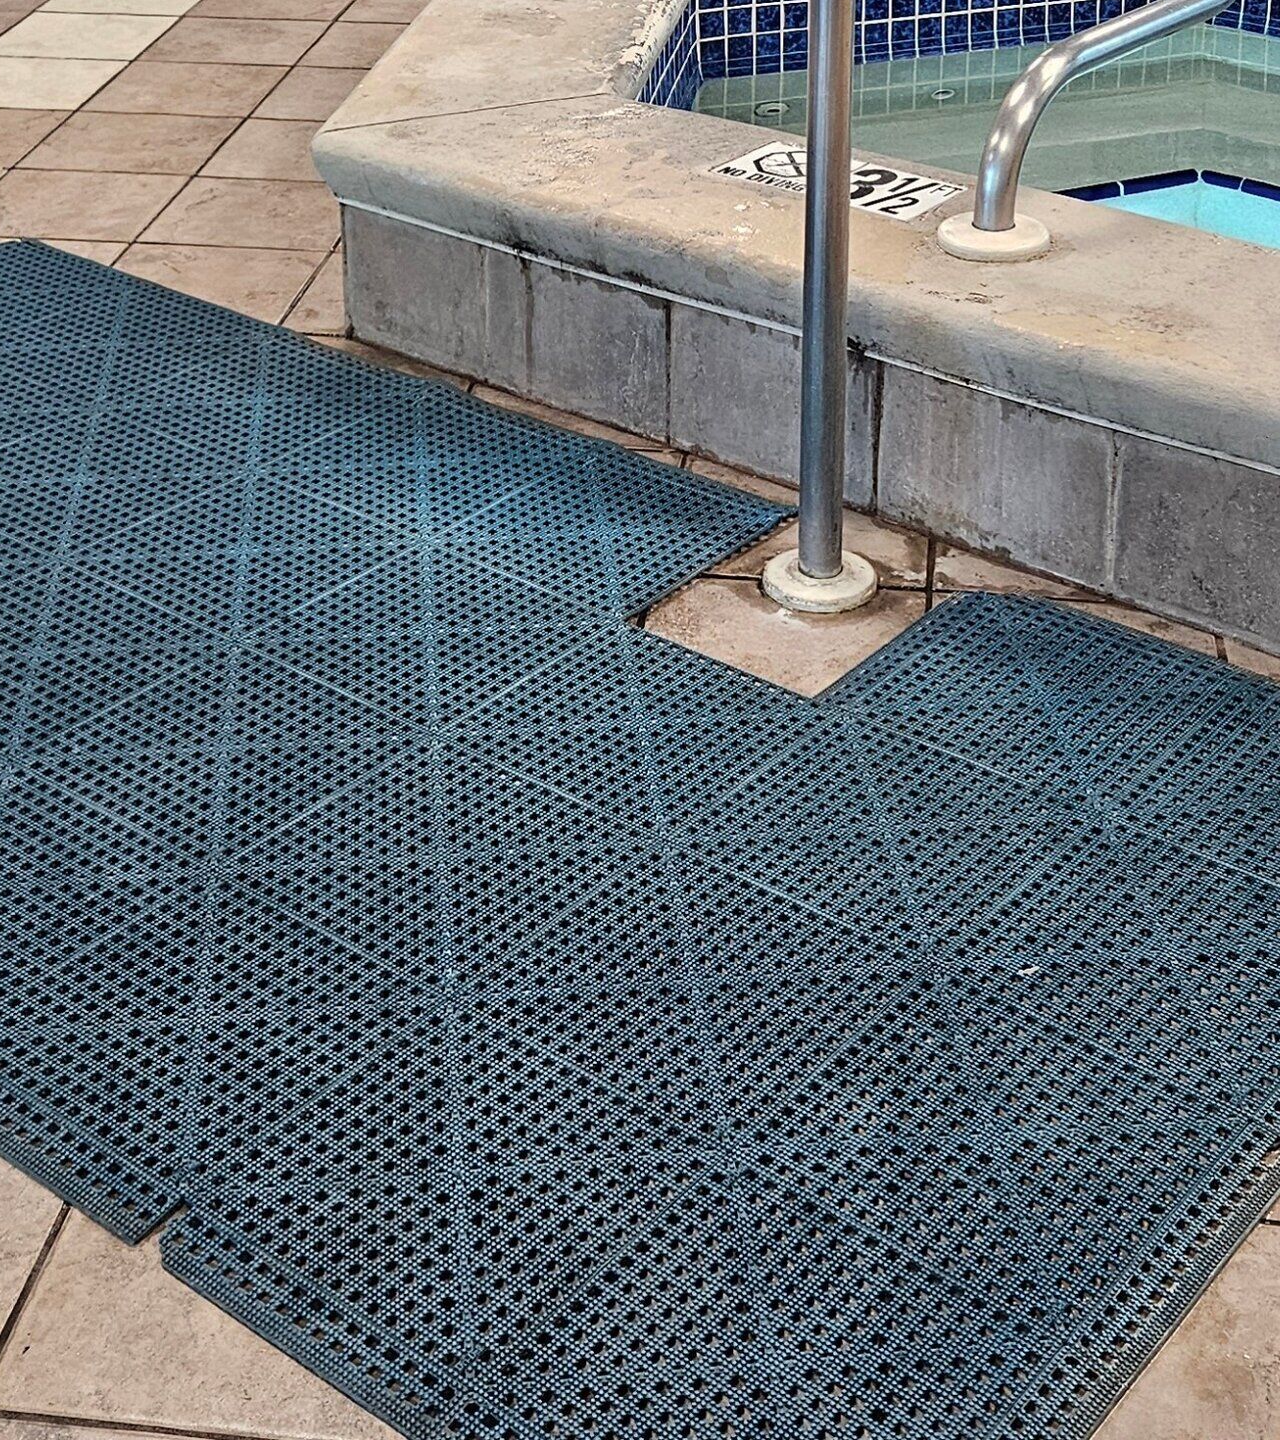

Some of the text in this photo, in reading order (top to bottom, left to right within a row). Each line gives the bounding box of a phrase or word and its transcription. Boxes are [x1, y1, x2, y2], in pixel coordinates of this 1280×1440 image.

[718, 166, 806, 192] NO DIVING
[930, 184, 964, 198] FT
